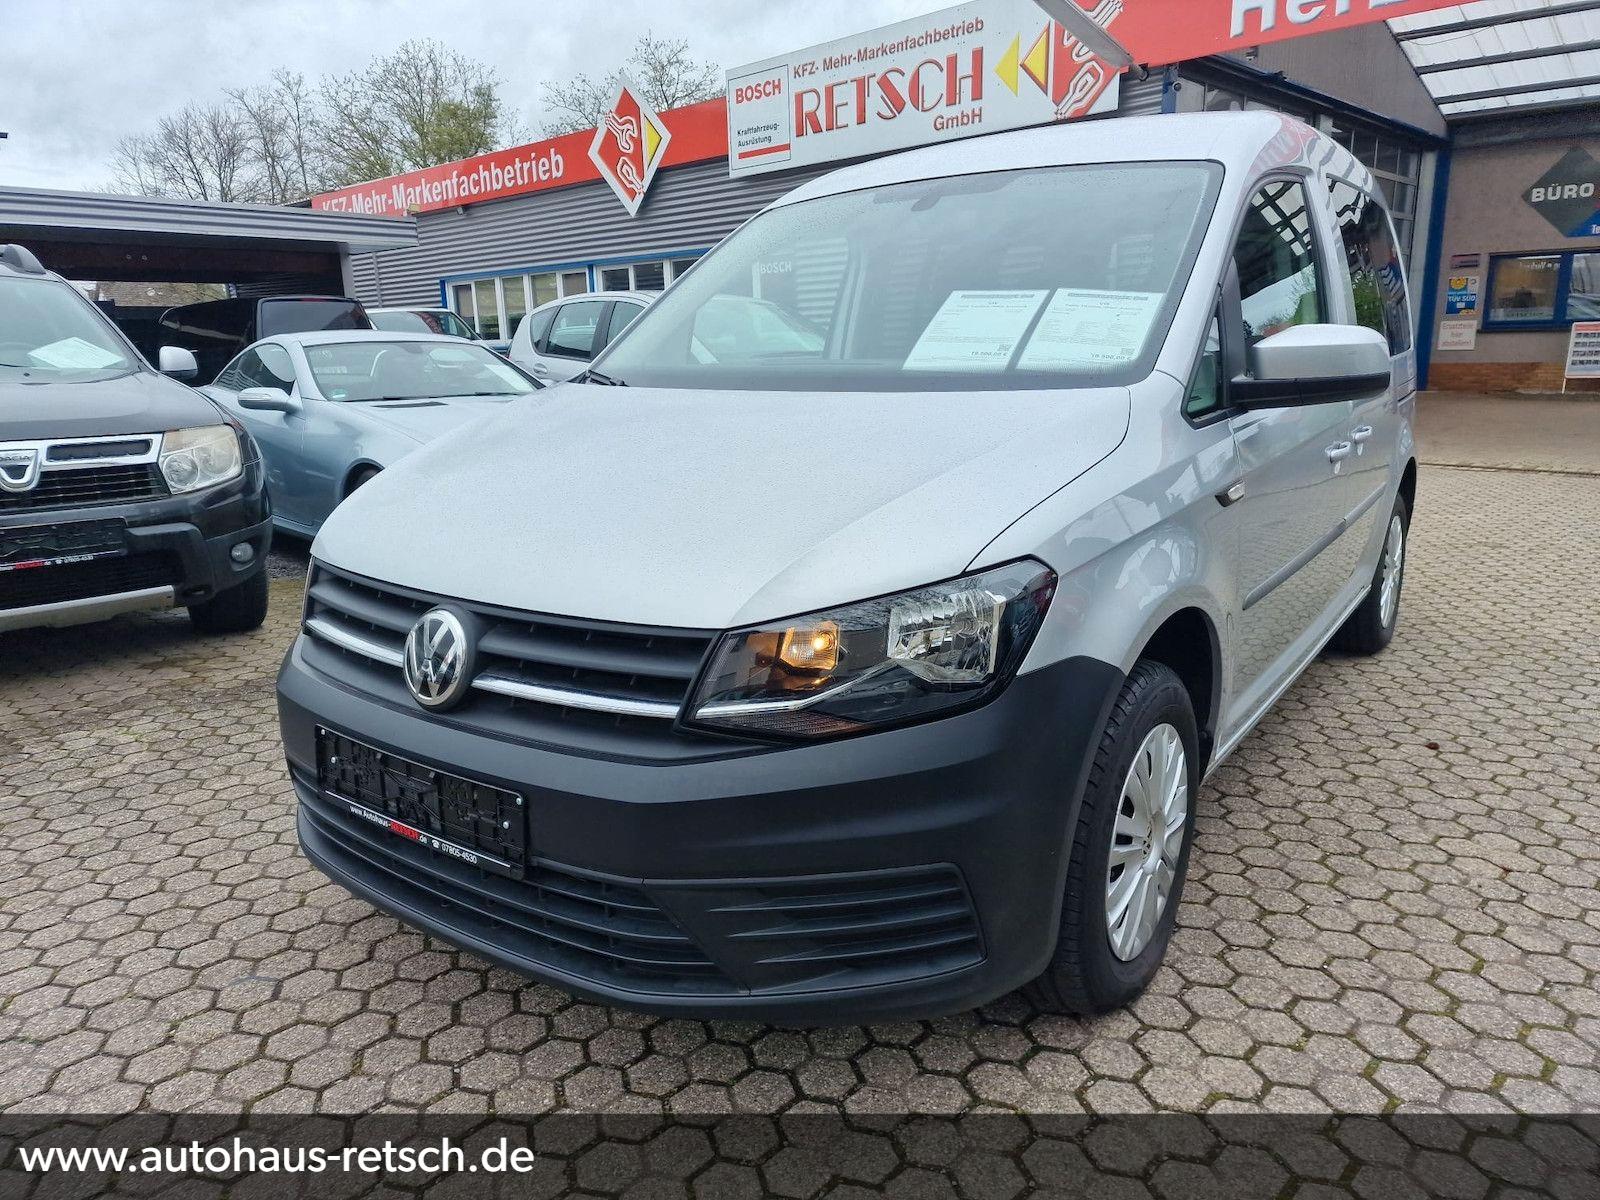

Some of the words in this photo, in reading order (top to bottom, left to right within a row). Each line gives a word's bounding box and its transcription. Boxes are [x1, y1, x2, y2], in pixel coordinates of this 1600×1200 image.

[792, 61, 822, 79] KFZ-
[823, 17, 985, 70] Mehr-Markenfachbetrieb
[735, 78, 782, 104] BOSCH
[794, 46, 984, 138] RETSCH
[737, 122, 780, 136] Kraftfahrzeug-
[933, 107, 983, 132] GmbH
[737, 135, 773, 148] Ausrüstung
[1531, 182, 1595, 203] BÜRO
[760, 261, 792, 274] BOSCH
